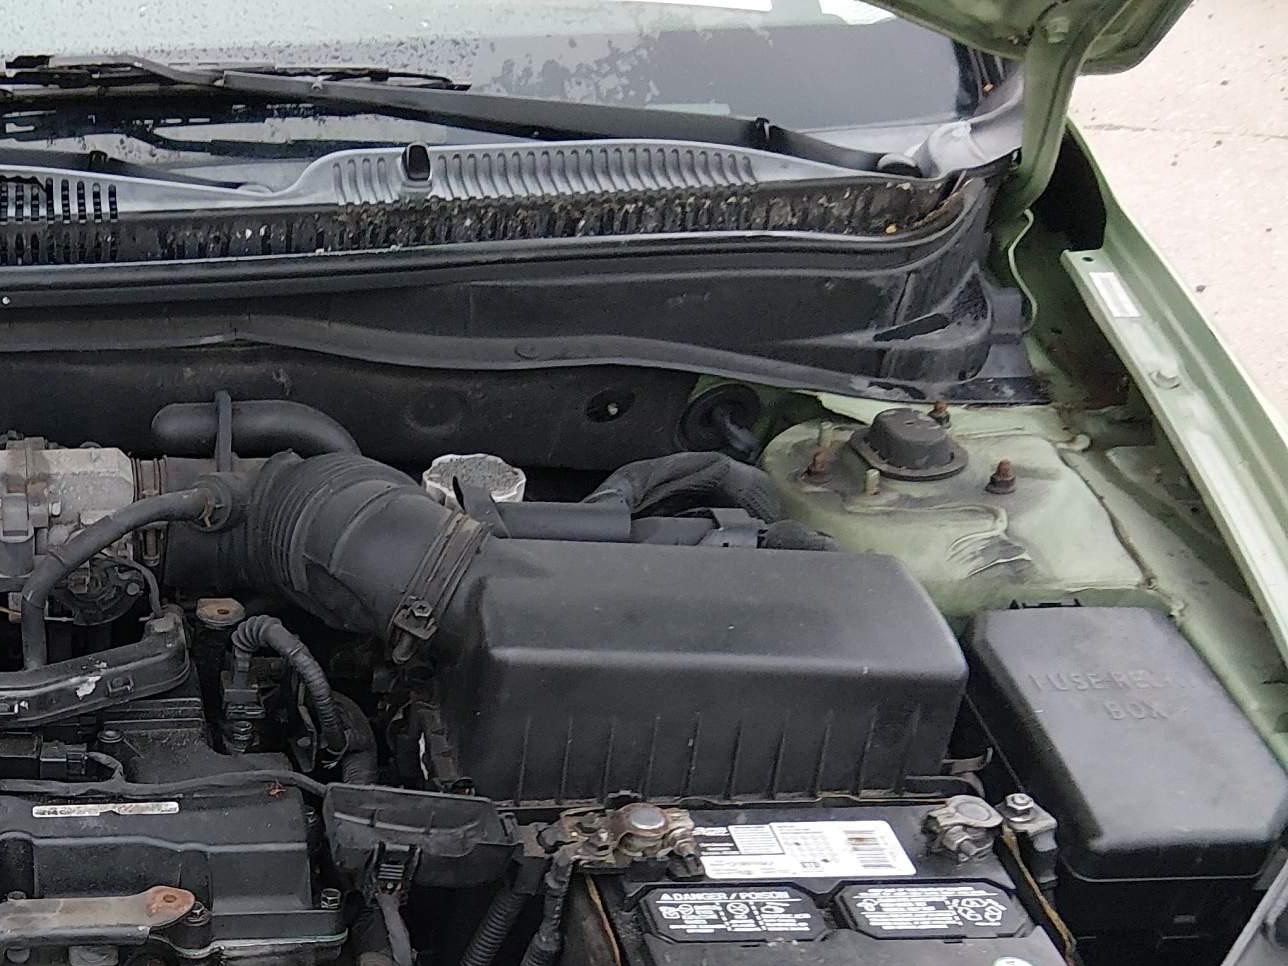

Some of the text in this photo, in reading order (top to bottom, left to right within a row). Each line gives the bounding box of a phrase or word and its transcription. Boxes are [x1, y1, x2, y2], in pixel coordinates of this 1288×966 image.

[1104, 699, 1170, 721] BOX
[673, 893, 728, 901] DANGER
[739, 891, 790, 900] POISON
